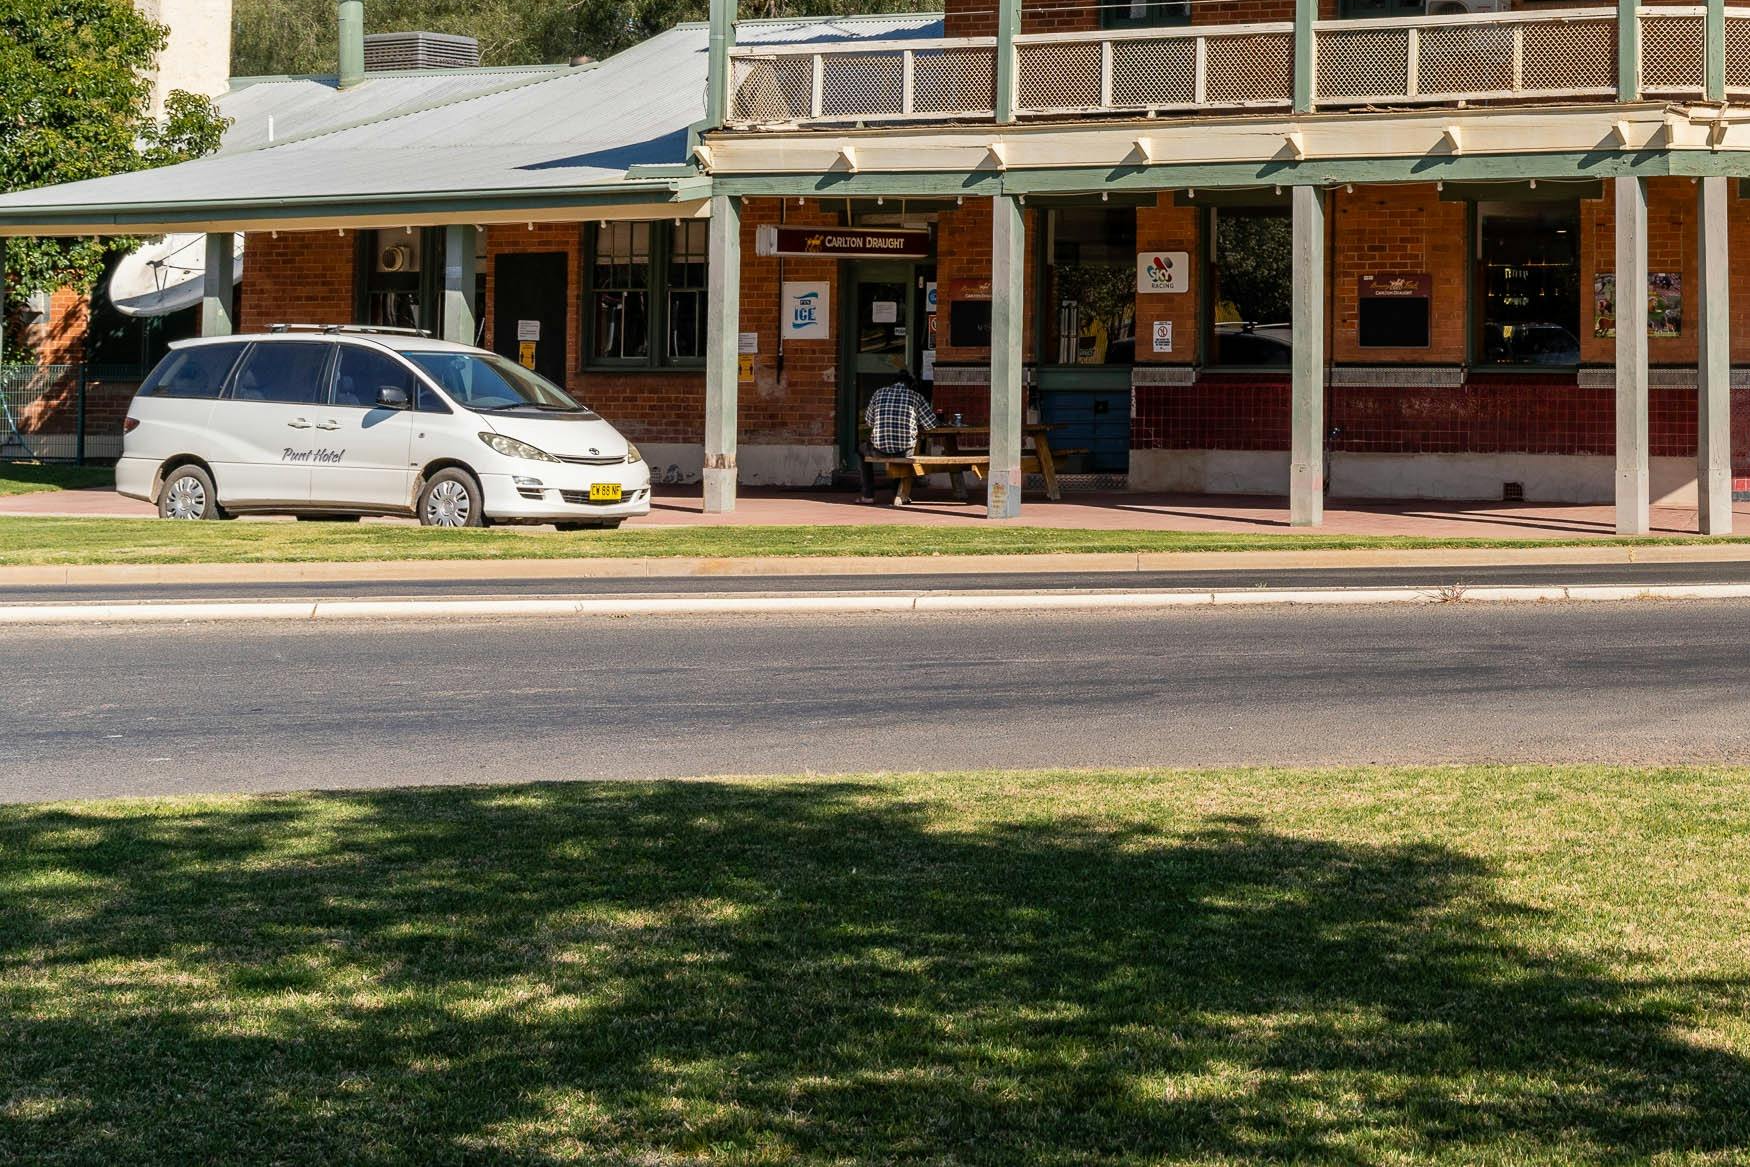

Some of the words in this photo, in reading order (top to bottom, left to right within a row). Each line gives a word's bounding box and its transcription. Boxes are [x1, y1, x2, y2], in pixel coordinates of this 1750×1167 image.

[825, 235, 863, 248] CARLTON
[865, 236, 905, 249] DRAUGHT
[794, 306, 817, 321] ICE
[281, 447, 313, 462] Punt
[313, 448, 346, 464] Hotel
